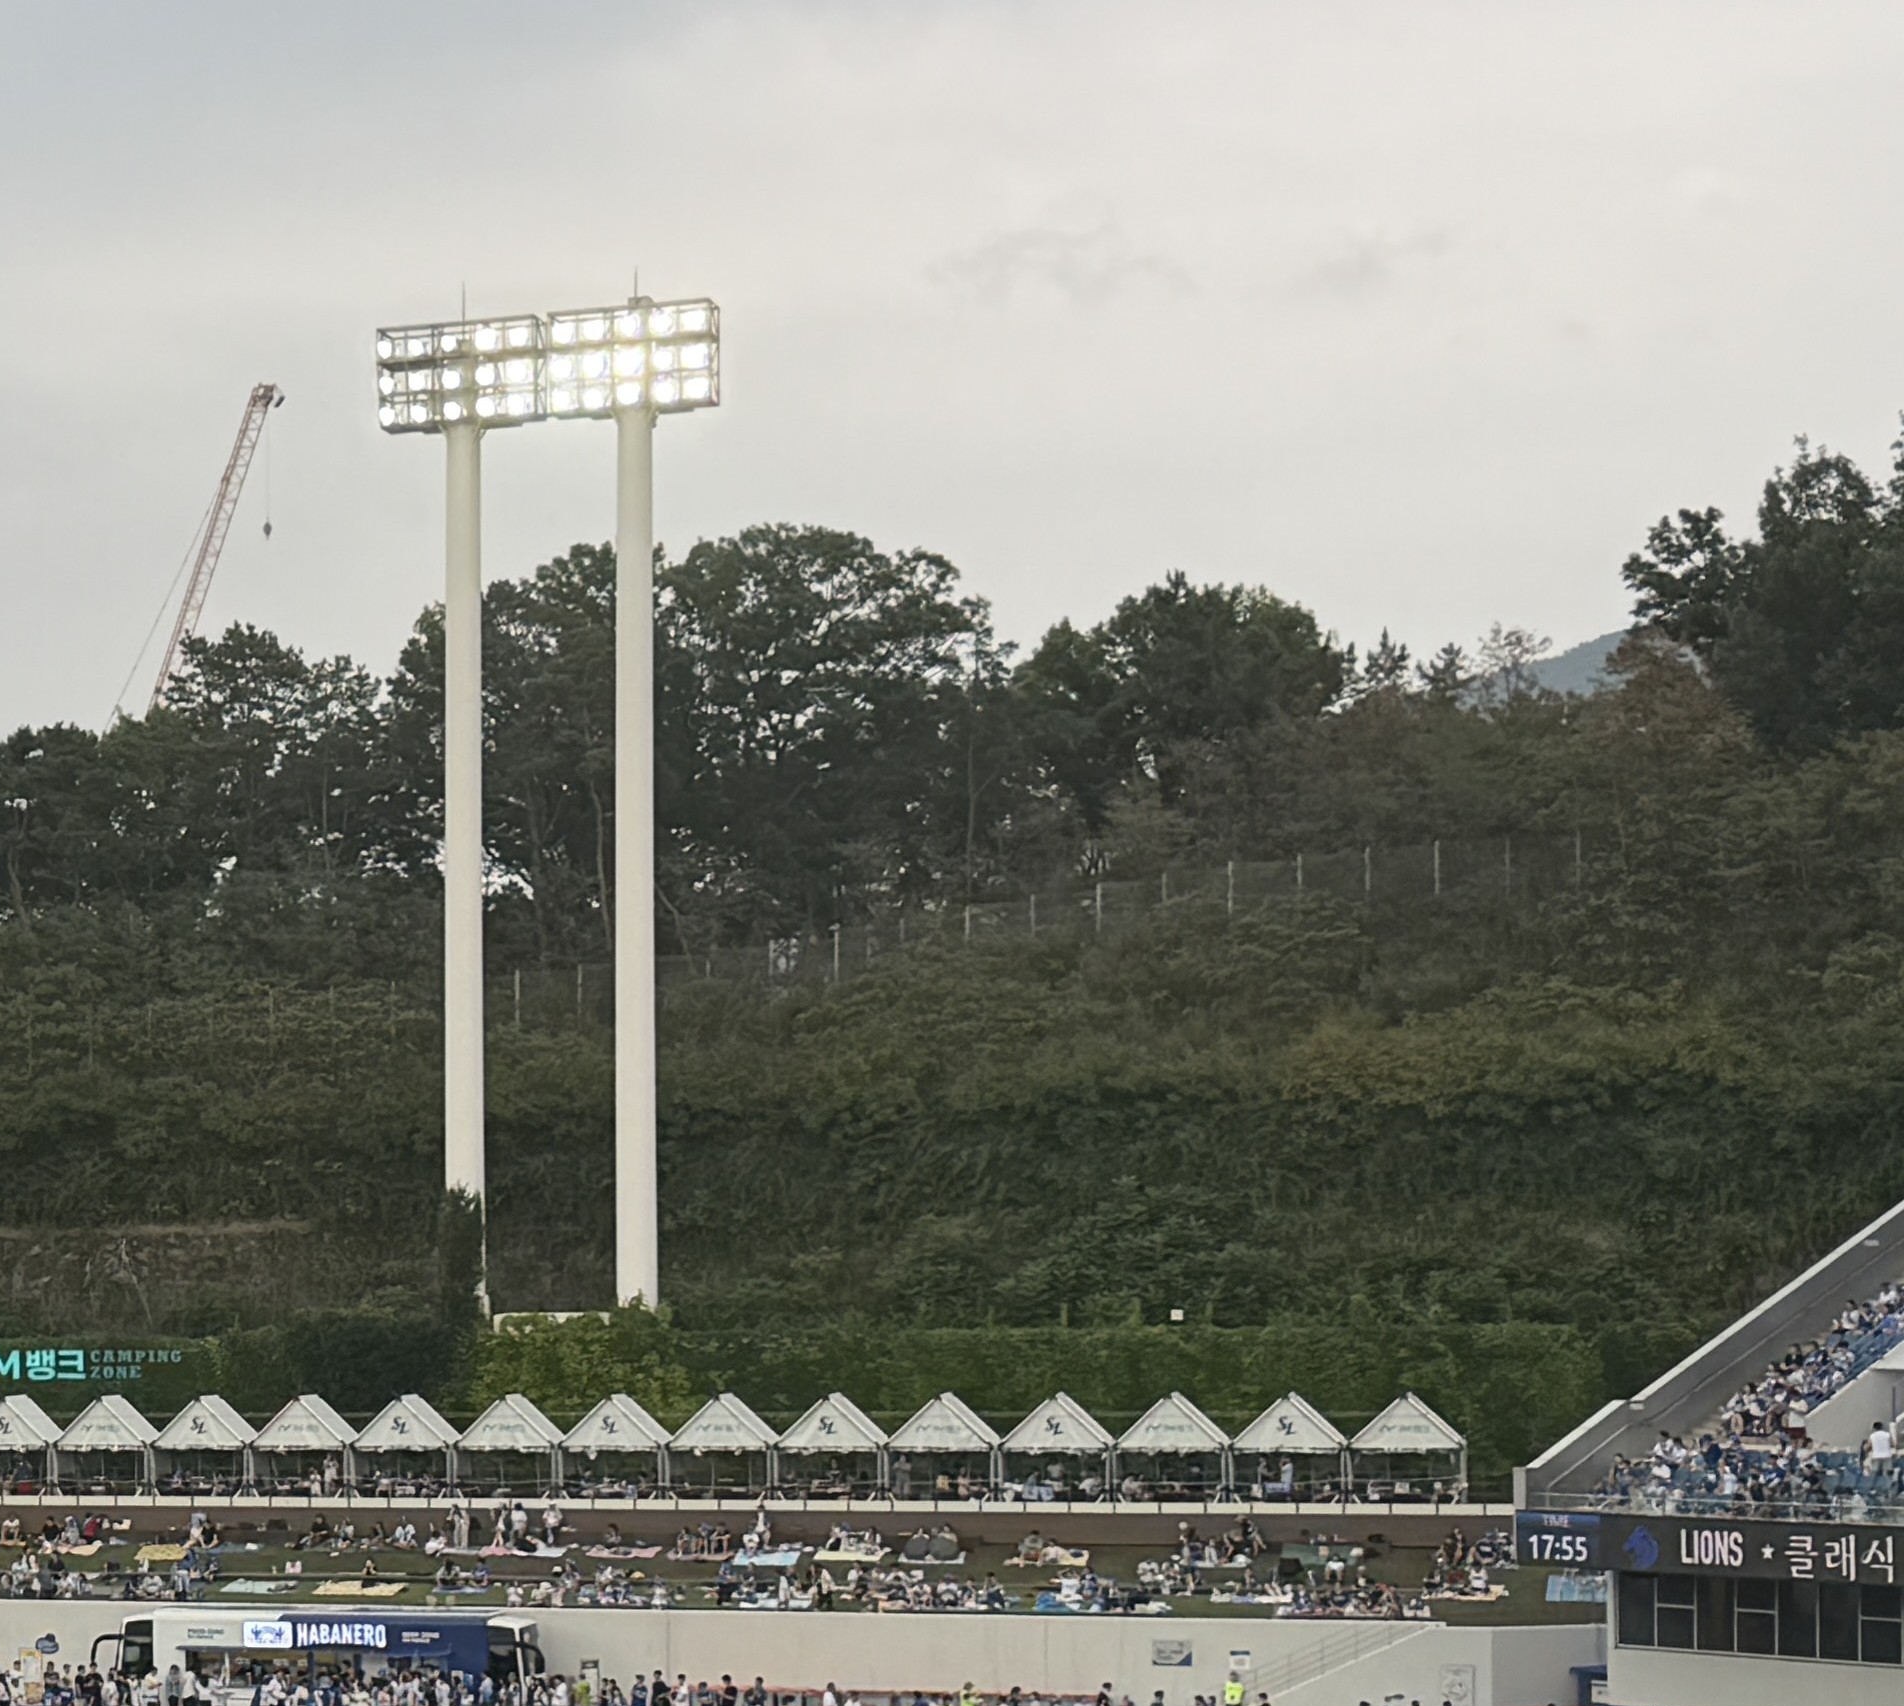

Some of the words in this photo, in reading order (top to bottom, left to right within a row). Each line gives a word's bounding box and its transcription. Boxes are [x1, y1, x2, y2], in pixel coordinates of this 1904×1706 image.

[90, 1350, 182, 1363] CAMPING
[90, 1366, 142, 1379] ZONE
[1527, 1535, 1588, 1562] 17:55
[1680, 1529, 1744, 1567] LIONS
[1783, 1533, 1894, 1583] 클래식
[296, 1623, 386, 1648] HABANERO
